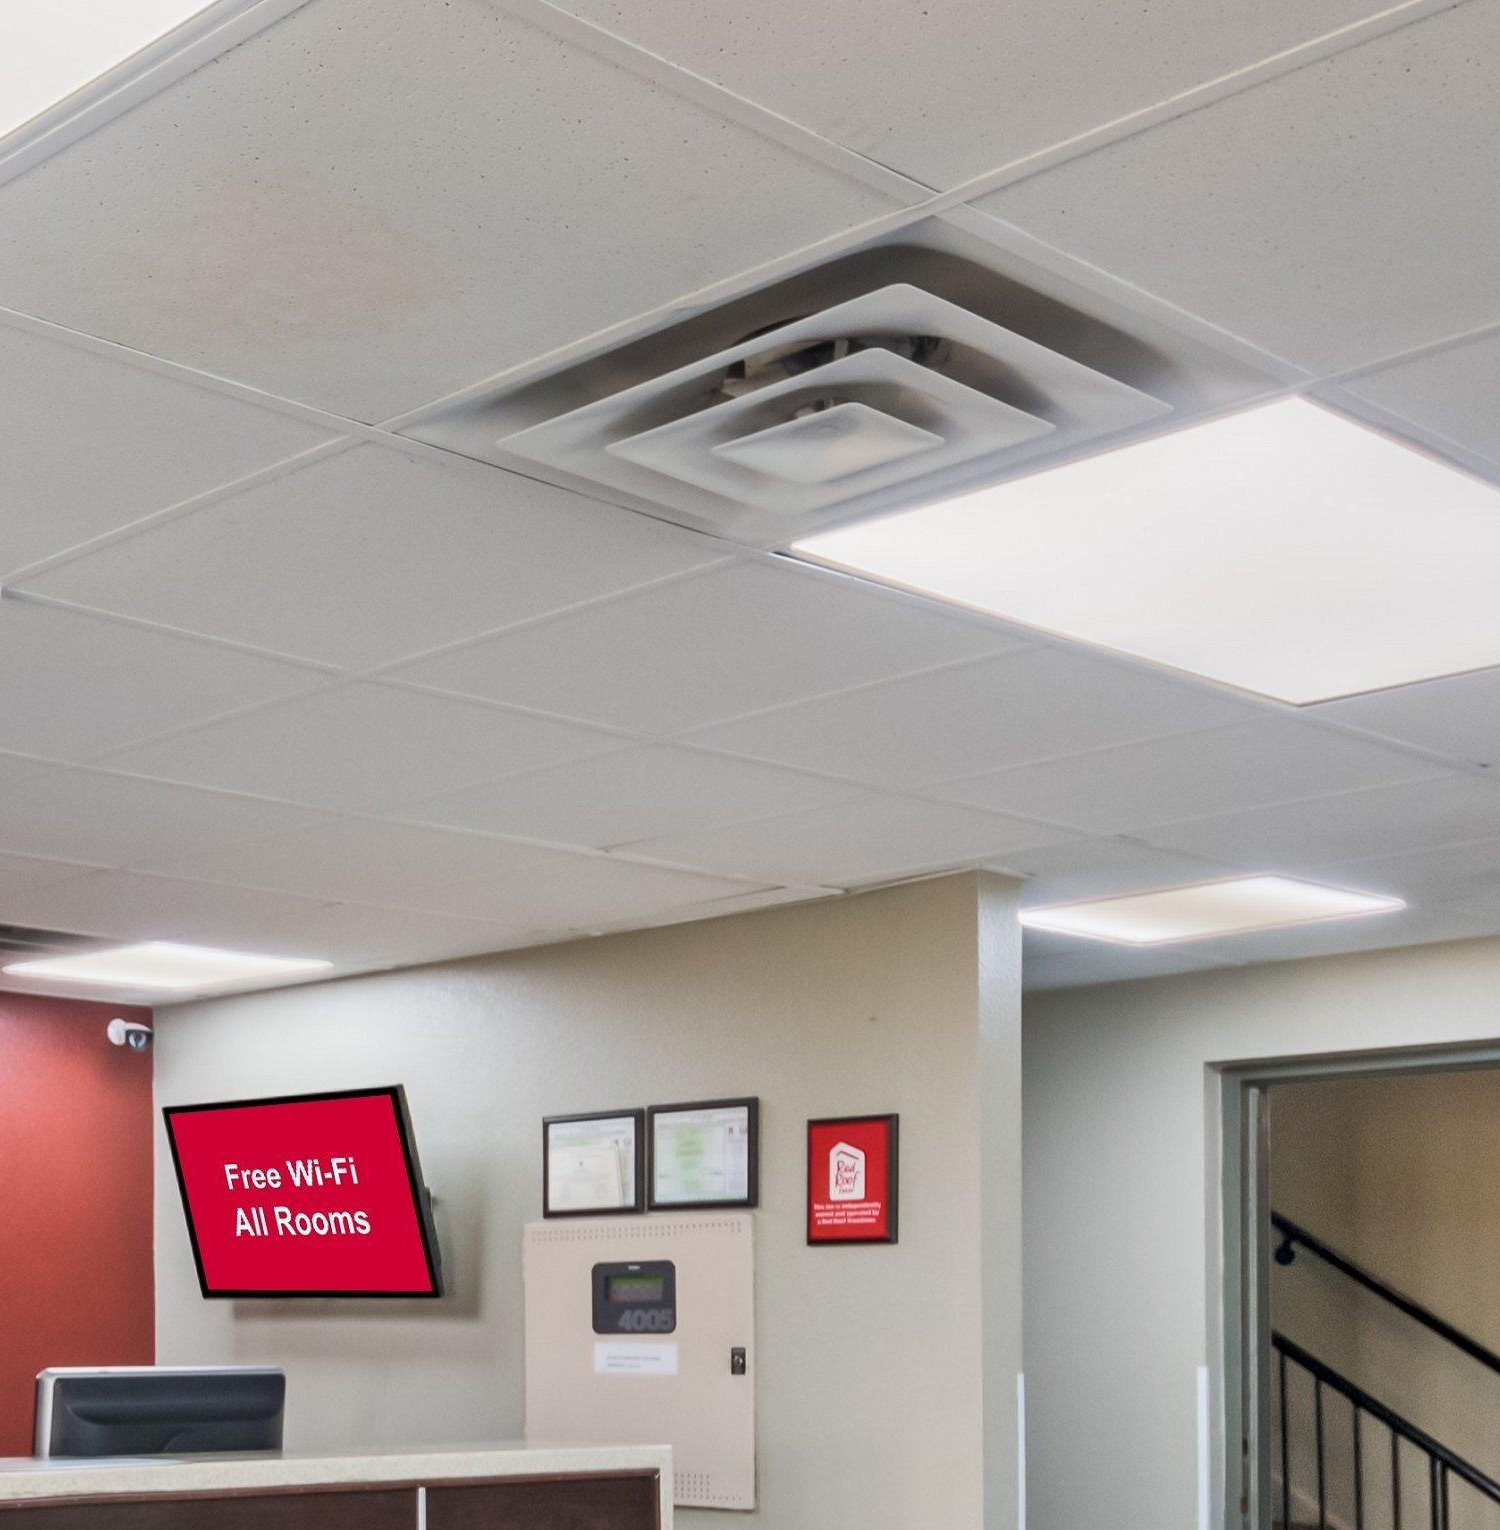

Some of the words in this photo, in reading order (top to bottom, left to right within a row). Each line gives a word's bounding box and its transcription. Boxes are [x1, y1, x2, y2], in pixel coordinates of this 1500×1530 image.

[224, 1163, 281, 1190] Free
[286, 1156, 358, 1187] Wi-Fi
[236, 1207, 269, 1237] All
[273, 1206, 371, 1236] Rooms
[618, 1309, 674, 1331] 4005
